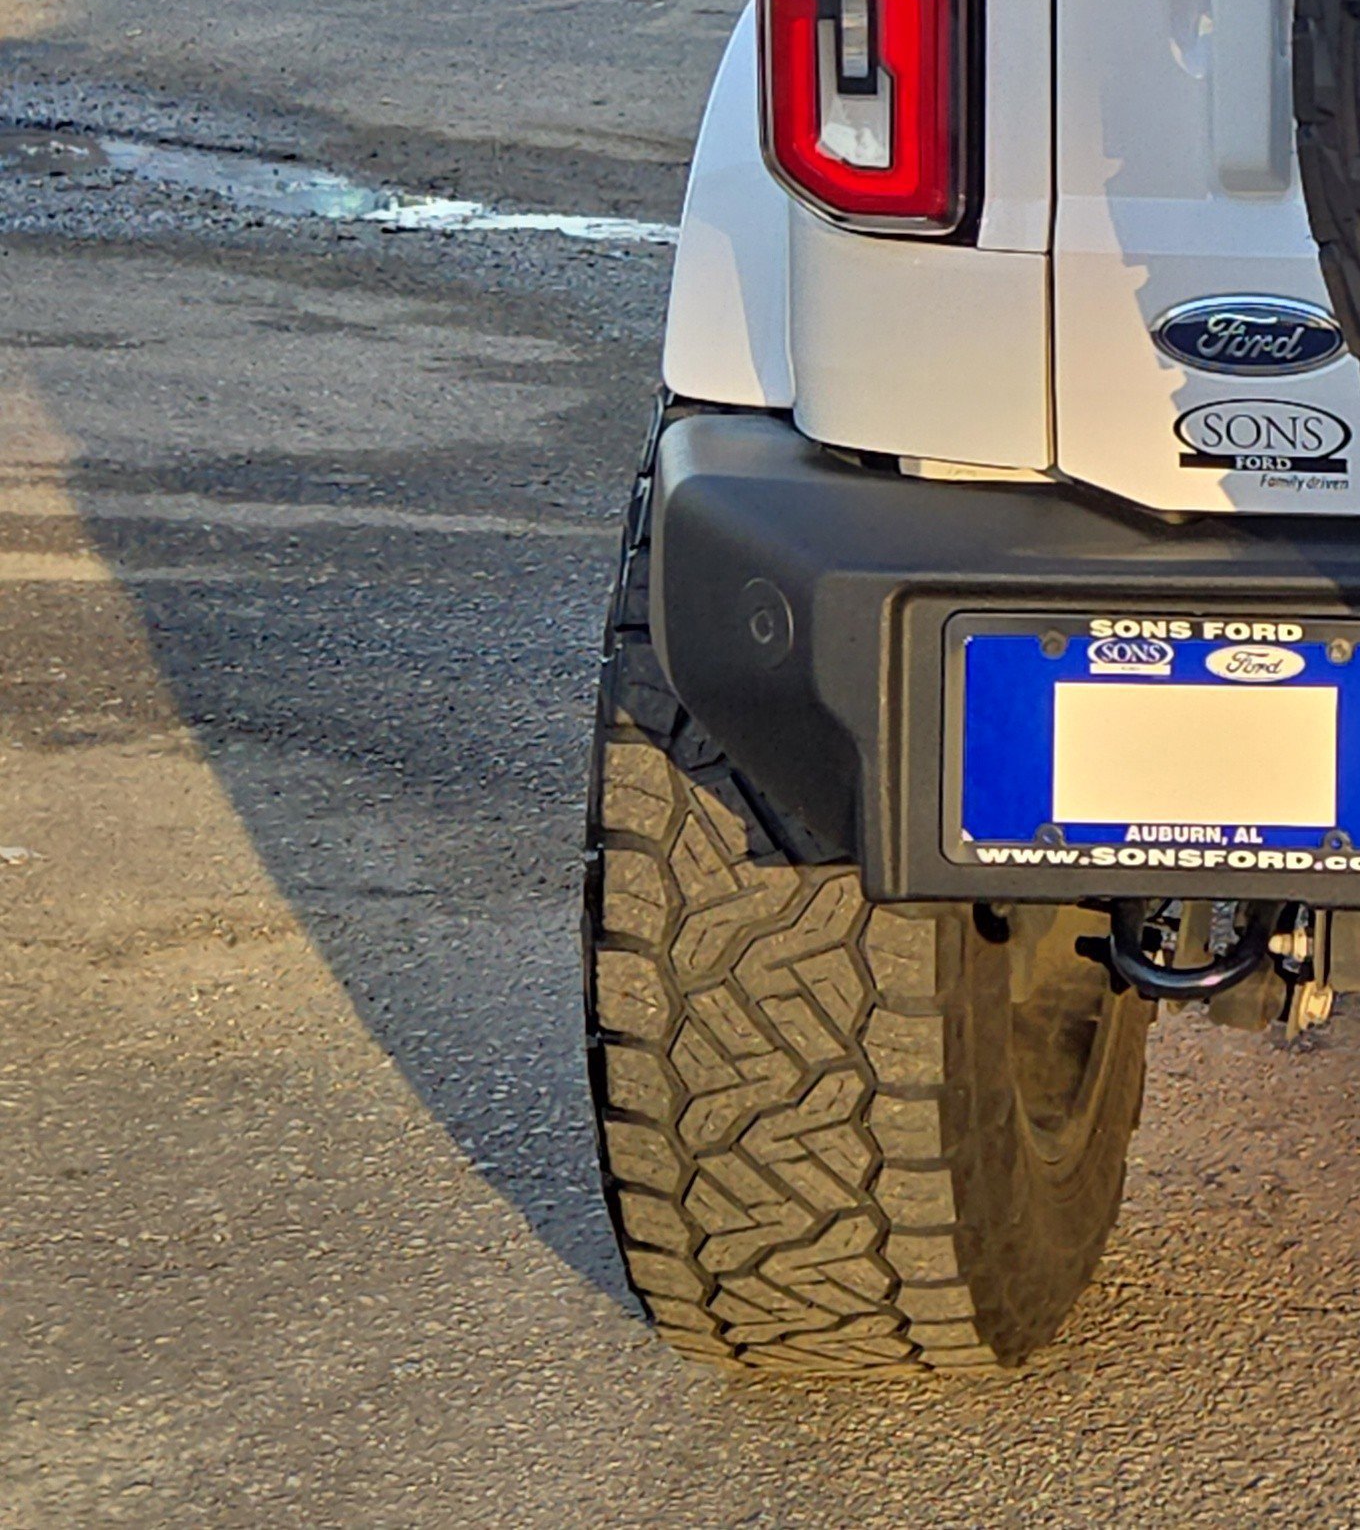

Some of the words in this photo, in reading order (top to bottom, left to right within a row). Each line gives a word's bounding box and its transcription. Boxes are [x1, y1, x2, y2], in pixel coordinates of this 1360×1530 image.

[1196, 313, 1304, 360] Ford
[1201, 412, 1324, 451] SONS
[1234, 455, 1293, 471] FORD
[1260, 473, 1304, 492] Family
[1306, 474, 1349, 490] driven
[1090, 620, 1192, 639] SONS
[1202, 621, 1303, 642] FORD
[1100, 642, 1162, 663] SONS
[1225, 650, 1284, 675] Ford
[1125, 825, 1229, 845] AUBURN,
[1233, 827, 1263, 844] AL
